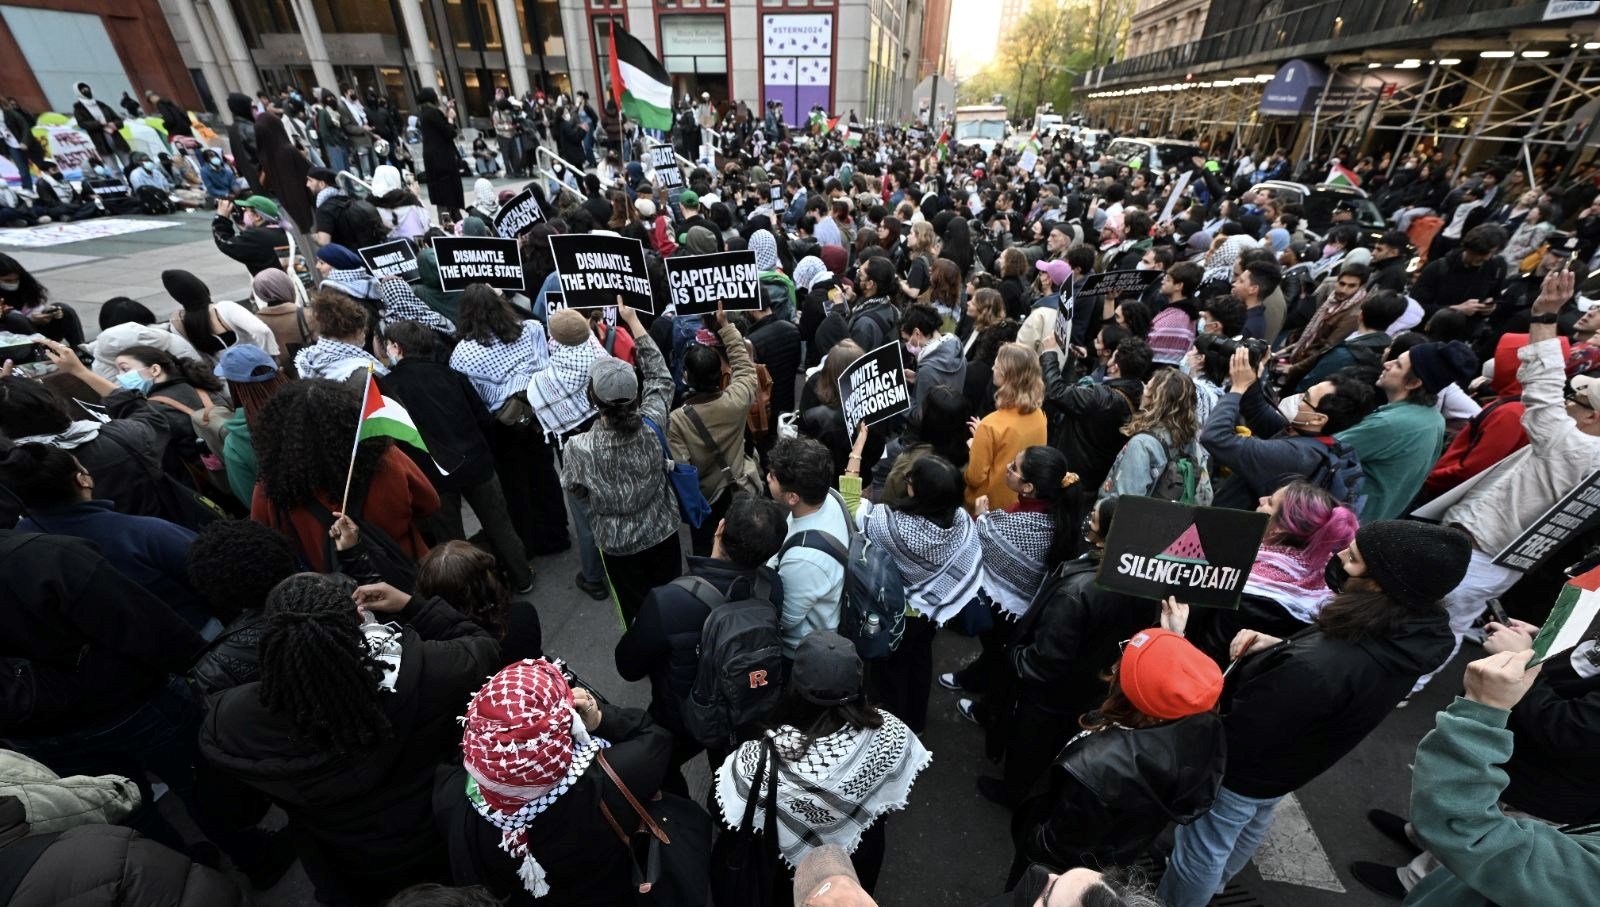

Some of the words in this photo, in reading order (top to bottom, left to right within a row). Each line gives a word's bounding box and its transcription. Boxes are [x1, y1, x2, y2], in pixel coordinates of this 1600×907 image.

[498, 196, 538, 237] CAPITALISM
[508, 206, 541, 238] DEADLY
[453, 250, 505, 263] DISMANTLE
[575, 252, 633, 272] DISMANTLE
[440, 265, 460, 279] THE
[461, 265, 493, 278] POLICE
[494, 265, 522, 279] STATE
[561, 274, 586, 291] THE
[587, 273, 624, 290] POLICE
[623, 275, 651, 296] STATE
[670, 263, 757, 289] CAPITALISM
[1095, 280, 1114, 288] NOT
[1116, 278, 1142, 286] DENY
[673, 288, 689, 305] IS
[694, 281, 759, 303] DEADLY
[850, 359, 879, 391] WHITE
[845, 368, 898, 418] SUPREMACY
[851, 384, 906, 428] TERRORISM
[1513, 533, 1560, 560] FREE
[1117, 553, 1242, 591] SILENCE=DEATH
[749, 669, 768, 689] R
